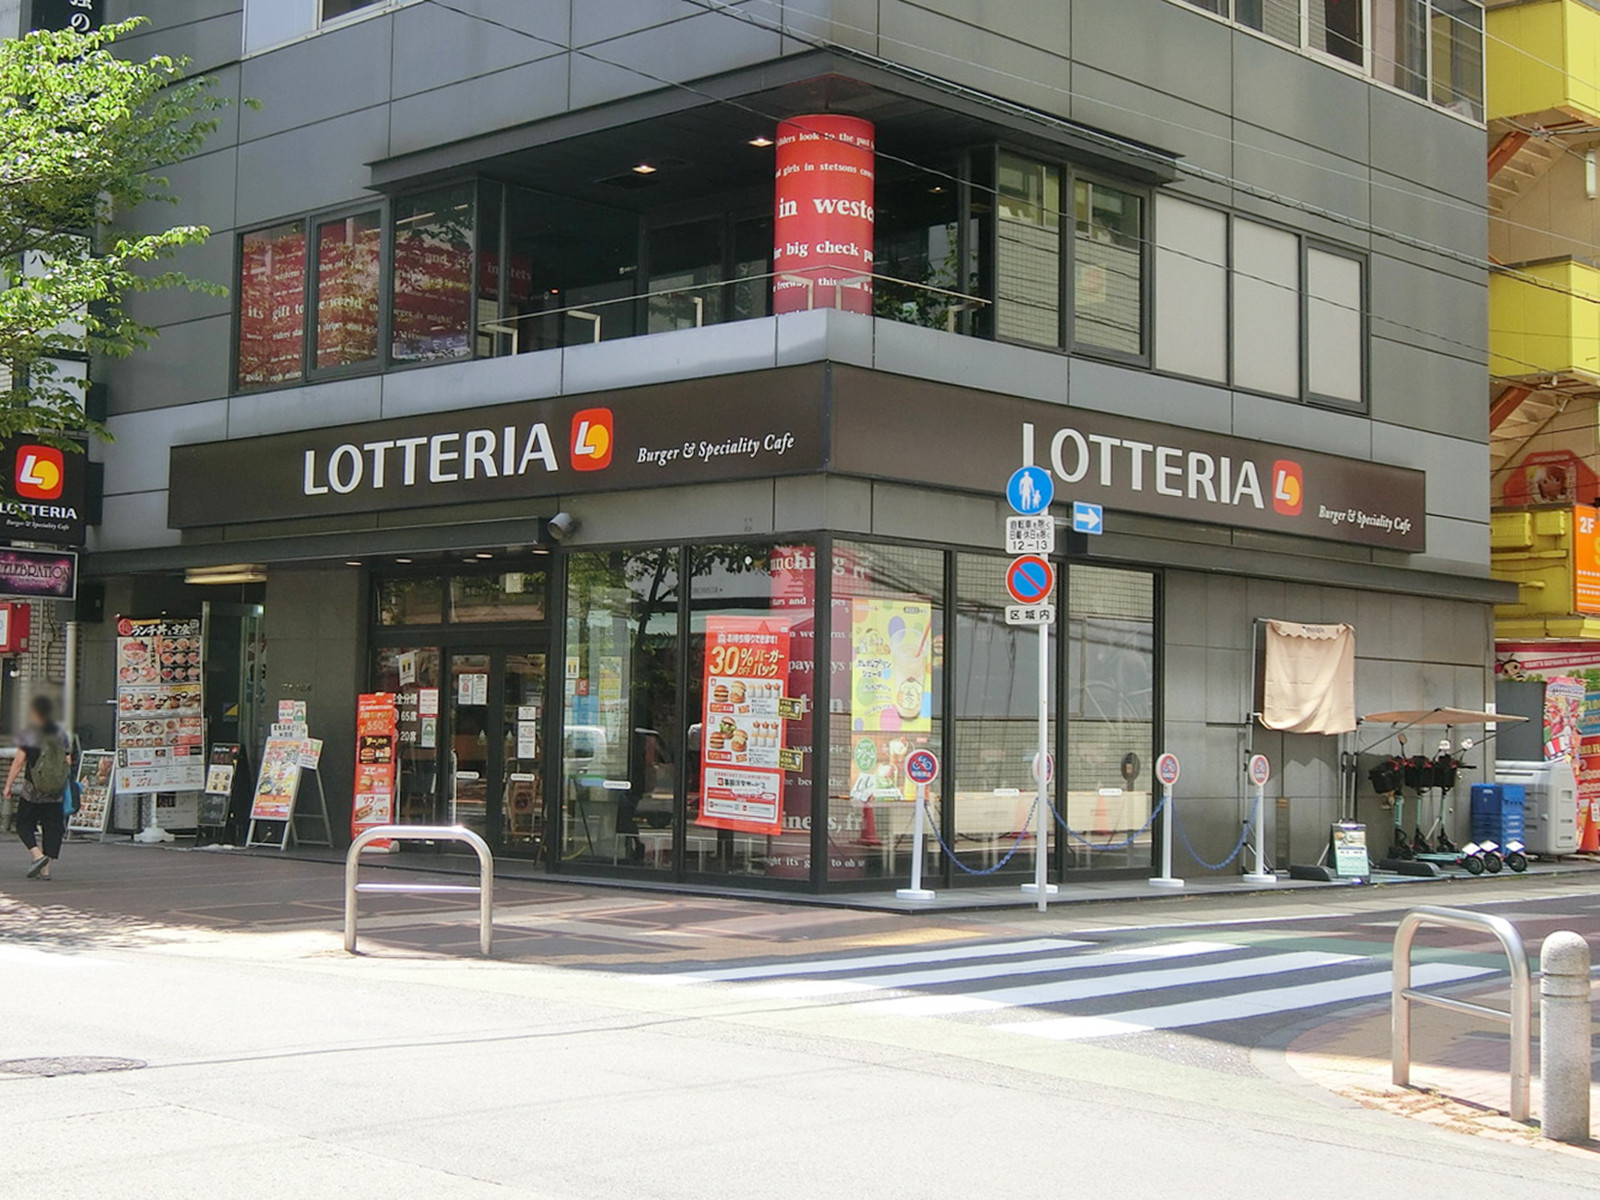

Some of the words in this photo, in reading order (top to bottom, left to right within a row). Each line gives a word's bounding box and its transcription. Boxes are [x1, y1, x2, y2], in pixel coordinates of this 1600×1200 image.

[799, 132, 820, 142] look
[783, 164, 801, 177] girls
[804, 162, 815, 172] in
[819, 162, 858, 174] stetsons
[779, 197, 799, 220] in
[786, 241, 809, 258] big
[815, 240, 860, 257] check
[247, 305, 265, 319] its
[271, 304, 291, 324] gift
[637, 446, 681, 467] Burger
[682, 442, 697, 459] &
[697, 435, 761, 463] Speciality
[763, 431, 796, 455] Cafe
[304, 423, 559, 495] LOTTERIA
[0, 502, 78, 520] LOTTERIA
[1318, 500, 1347, 525] Burger
[1346, 508, 1357, 523] &
[1356, 510, 1393, 533] Speciality
[1393, 516, 1412, 535] Cafe
[1579, 516, 1595, 534] 2F
[788, 597, 807, 606] and
[1010, 609, 1050, 620] 区域内
[754, 649, 785, 664] バーガー
